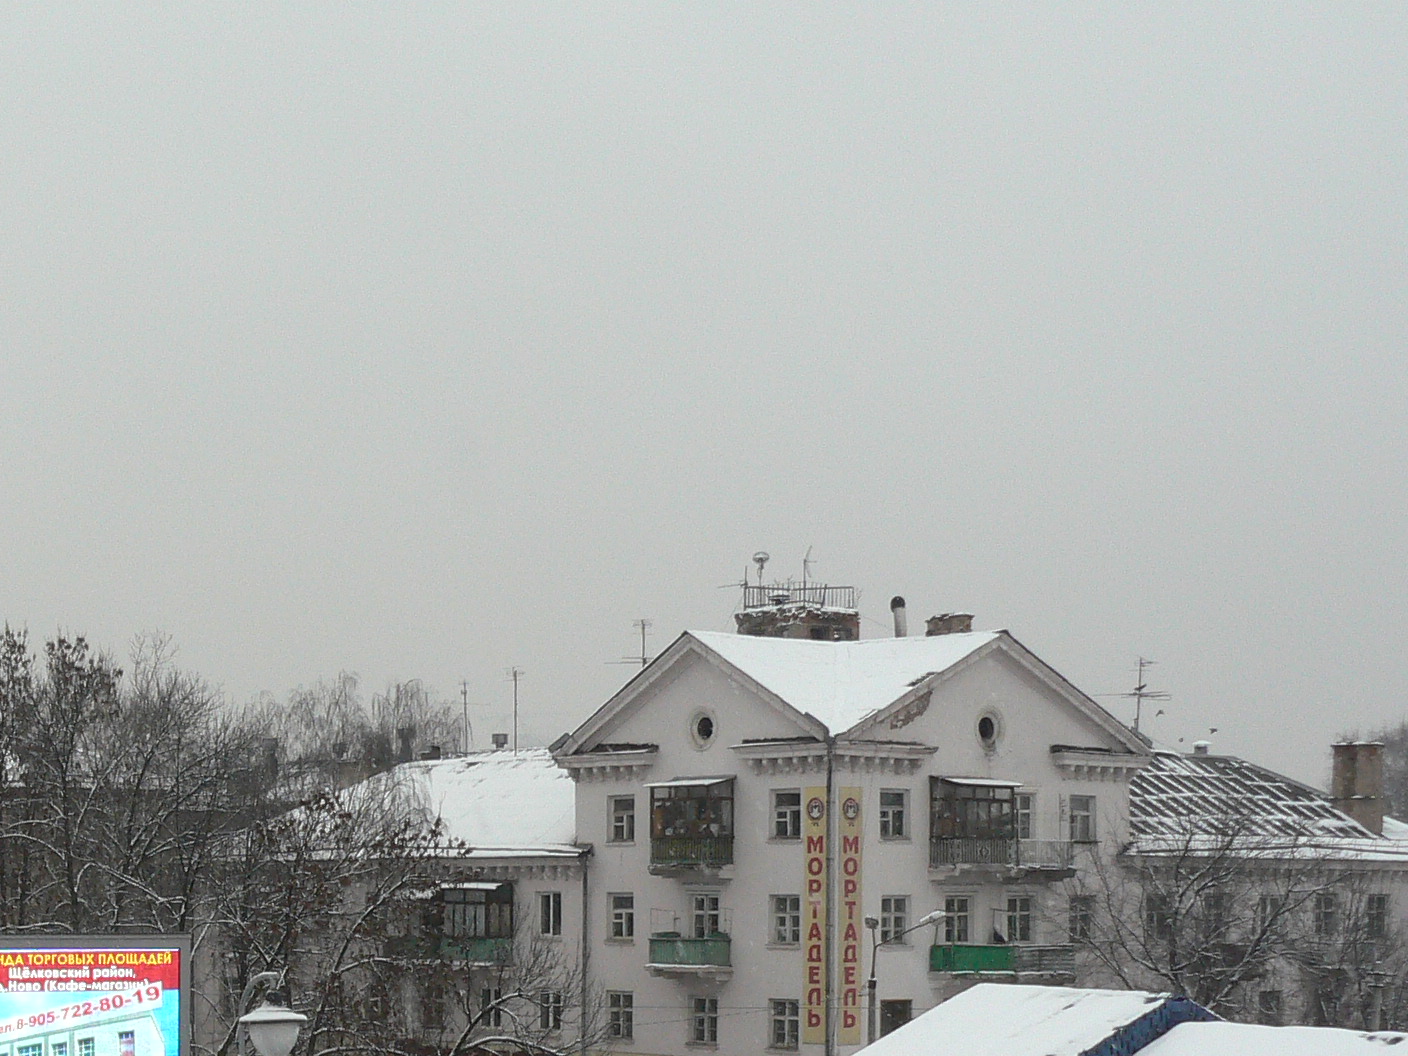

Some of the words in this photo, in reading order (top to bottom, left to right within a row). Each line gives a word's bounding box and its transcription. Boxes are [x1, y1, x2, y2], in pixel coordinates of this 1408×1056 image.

[8, 965, 90, 980] Щёлковский
[93, 965, 137, 980] район,
[28, 954, 94, 966] ТОРГОВЫХ
[98, 951, 172, 967] ПЛОЩАДЕЙ
[806, 835, 824, 1028] МОРТАДЕЛЬ
[842, 835, 860, 1029] МОРТАДЕЛЬ
